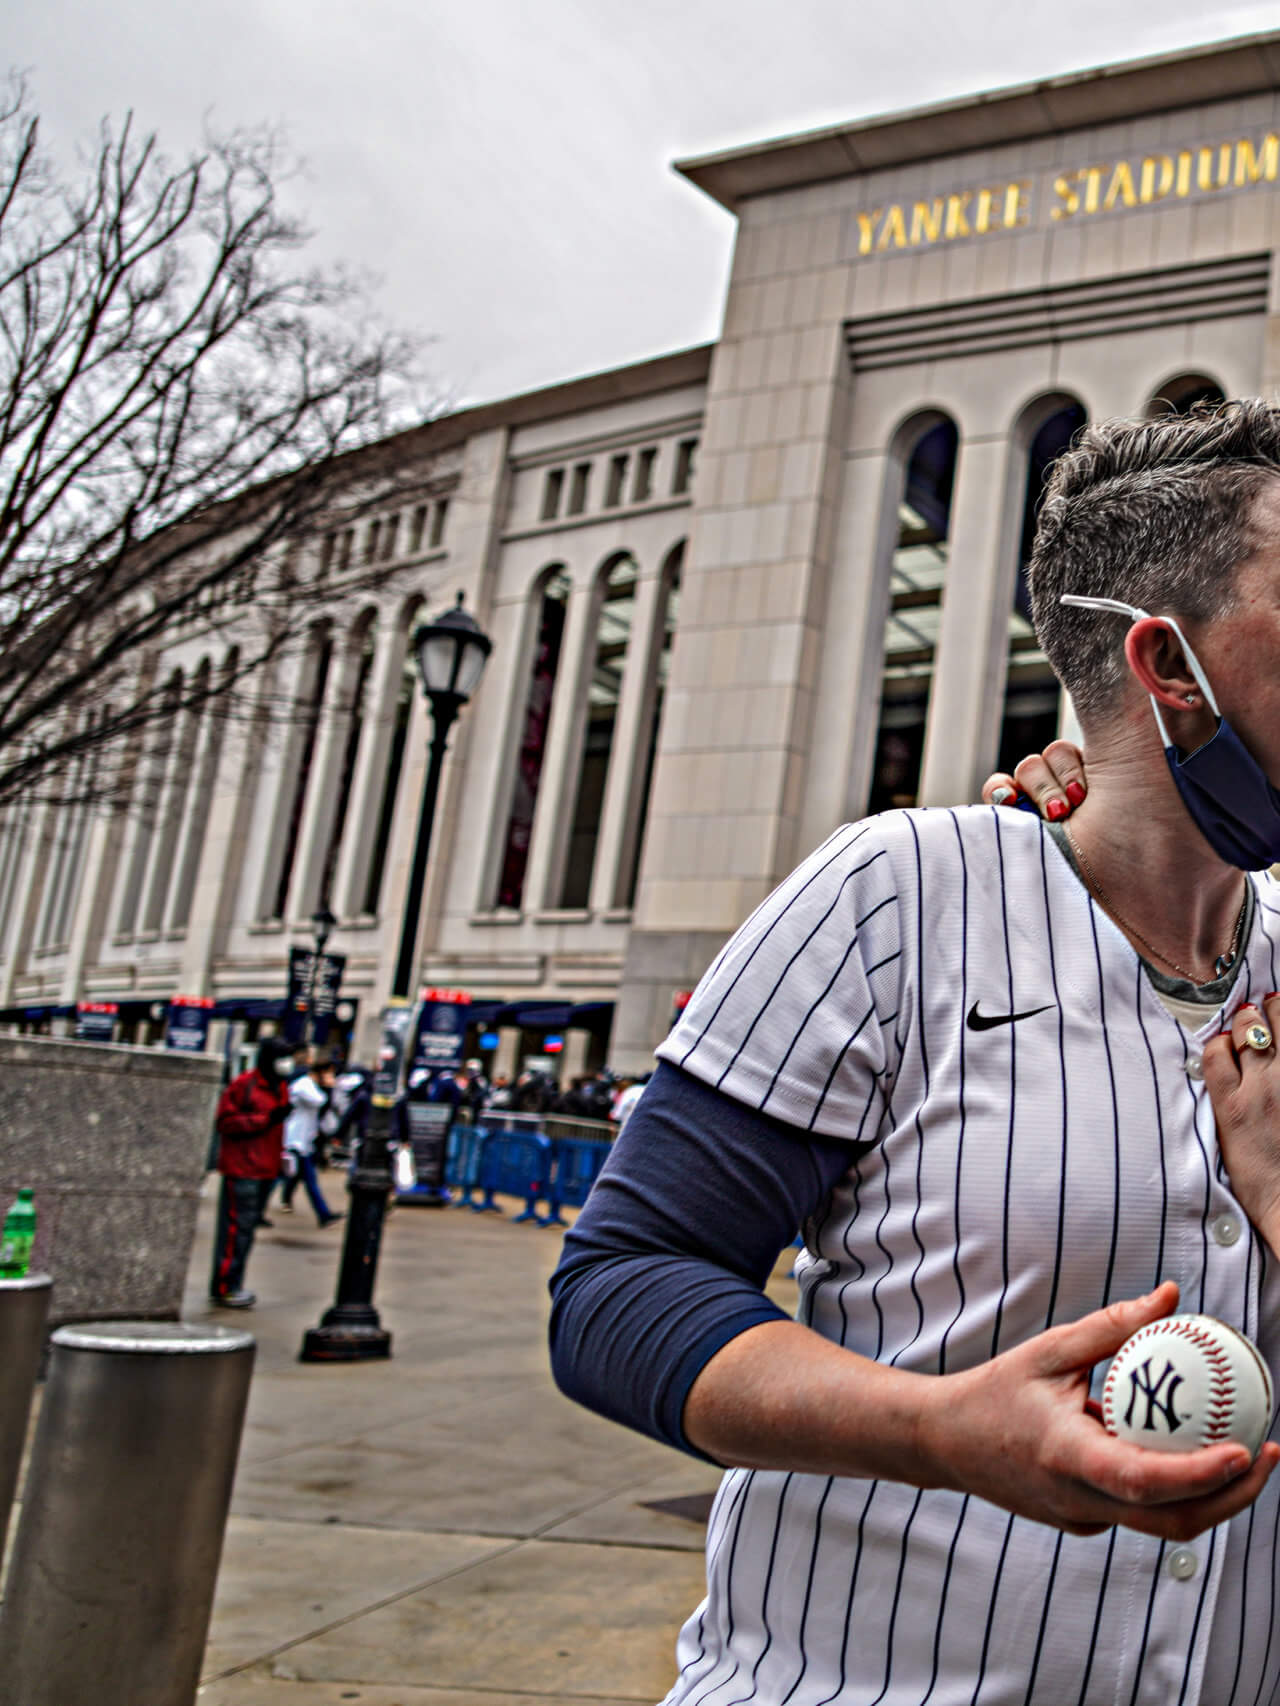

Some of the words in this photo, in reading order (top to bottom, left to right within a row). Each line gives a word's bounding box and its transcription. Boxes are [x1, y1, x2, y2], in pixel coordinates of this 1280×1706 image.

[856, 182, 1032, 255] YANKEE
[1050, 132, 1280, 221] STADIUM
[1123, 1356, 1185, 1433] NY
